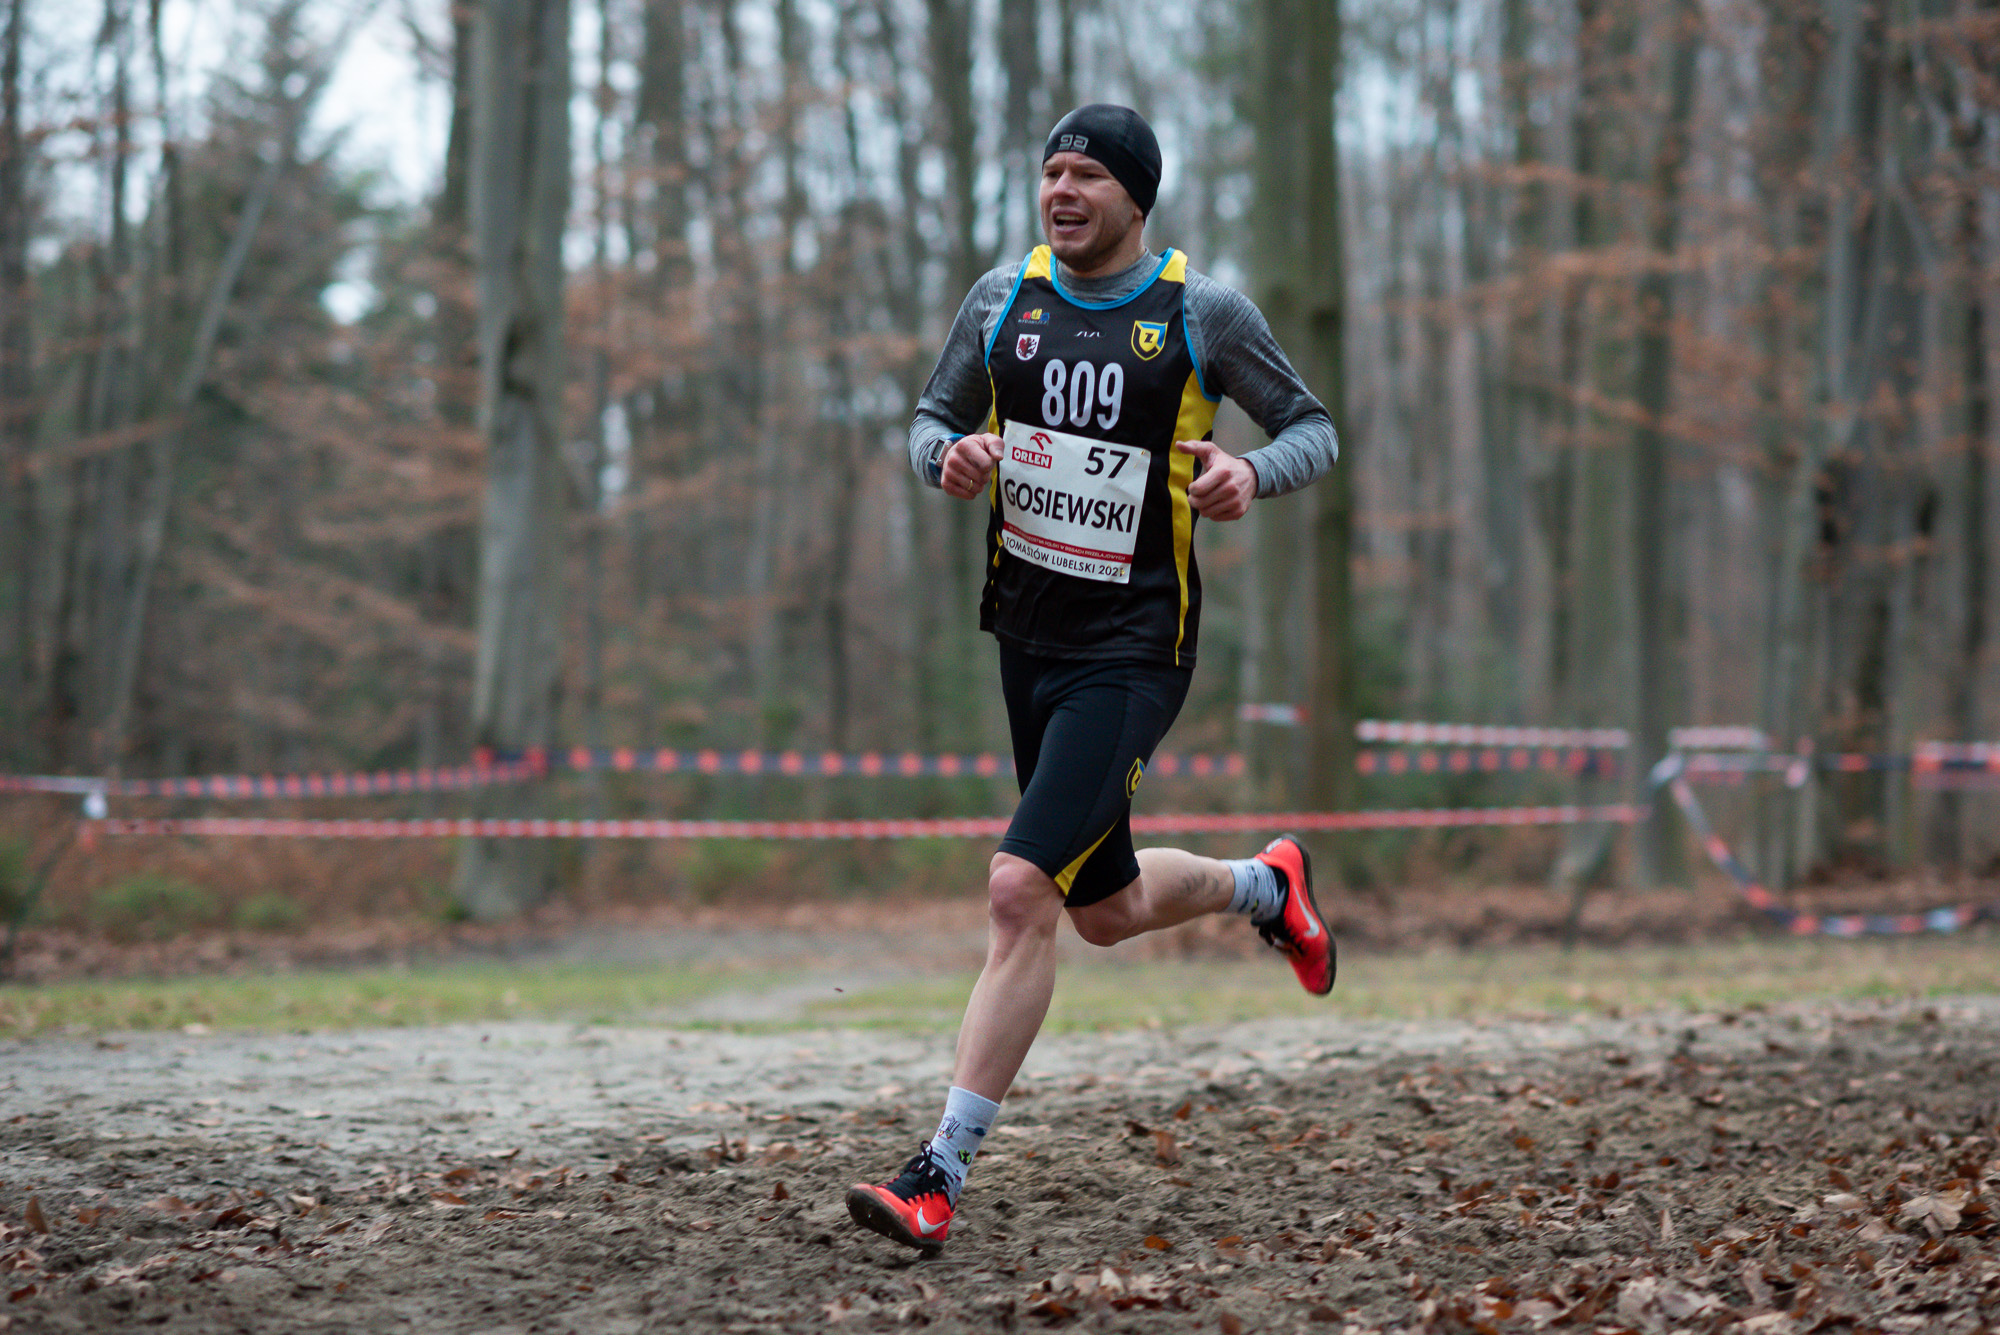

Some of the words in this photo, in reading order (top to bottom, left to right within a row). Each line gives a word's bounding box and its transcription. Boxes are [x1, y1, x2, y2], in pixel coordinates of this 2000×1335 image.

[1144, 332, 1154, 343] Z
[1041, 358, 1124, 430] 809
[1013, 448, 1050, 468] ORLEN
[1084, 446, 1130, 479] 57
[1004, 478, 1136, 533] GOSIEWSKI
[1051, 555, 1095, 574] LUBELSKI
